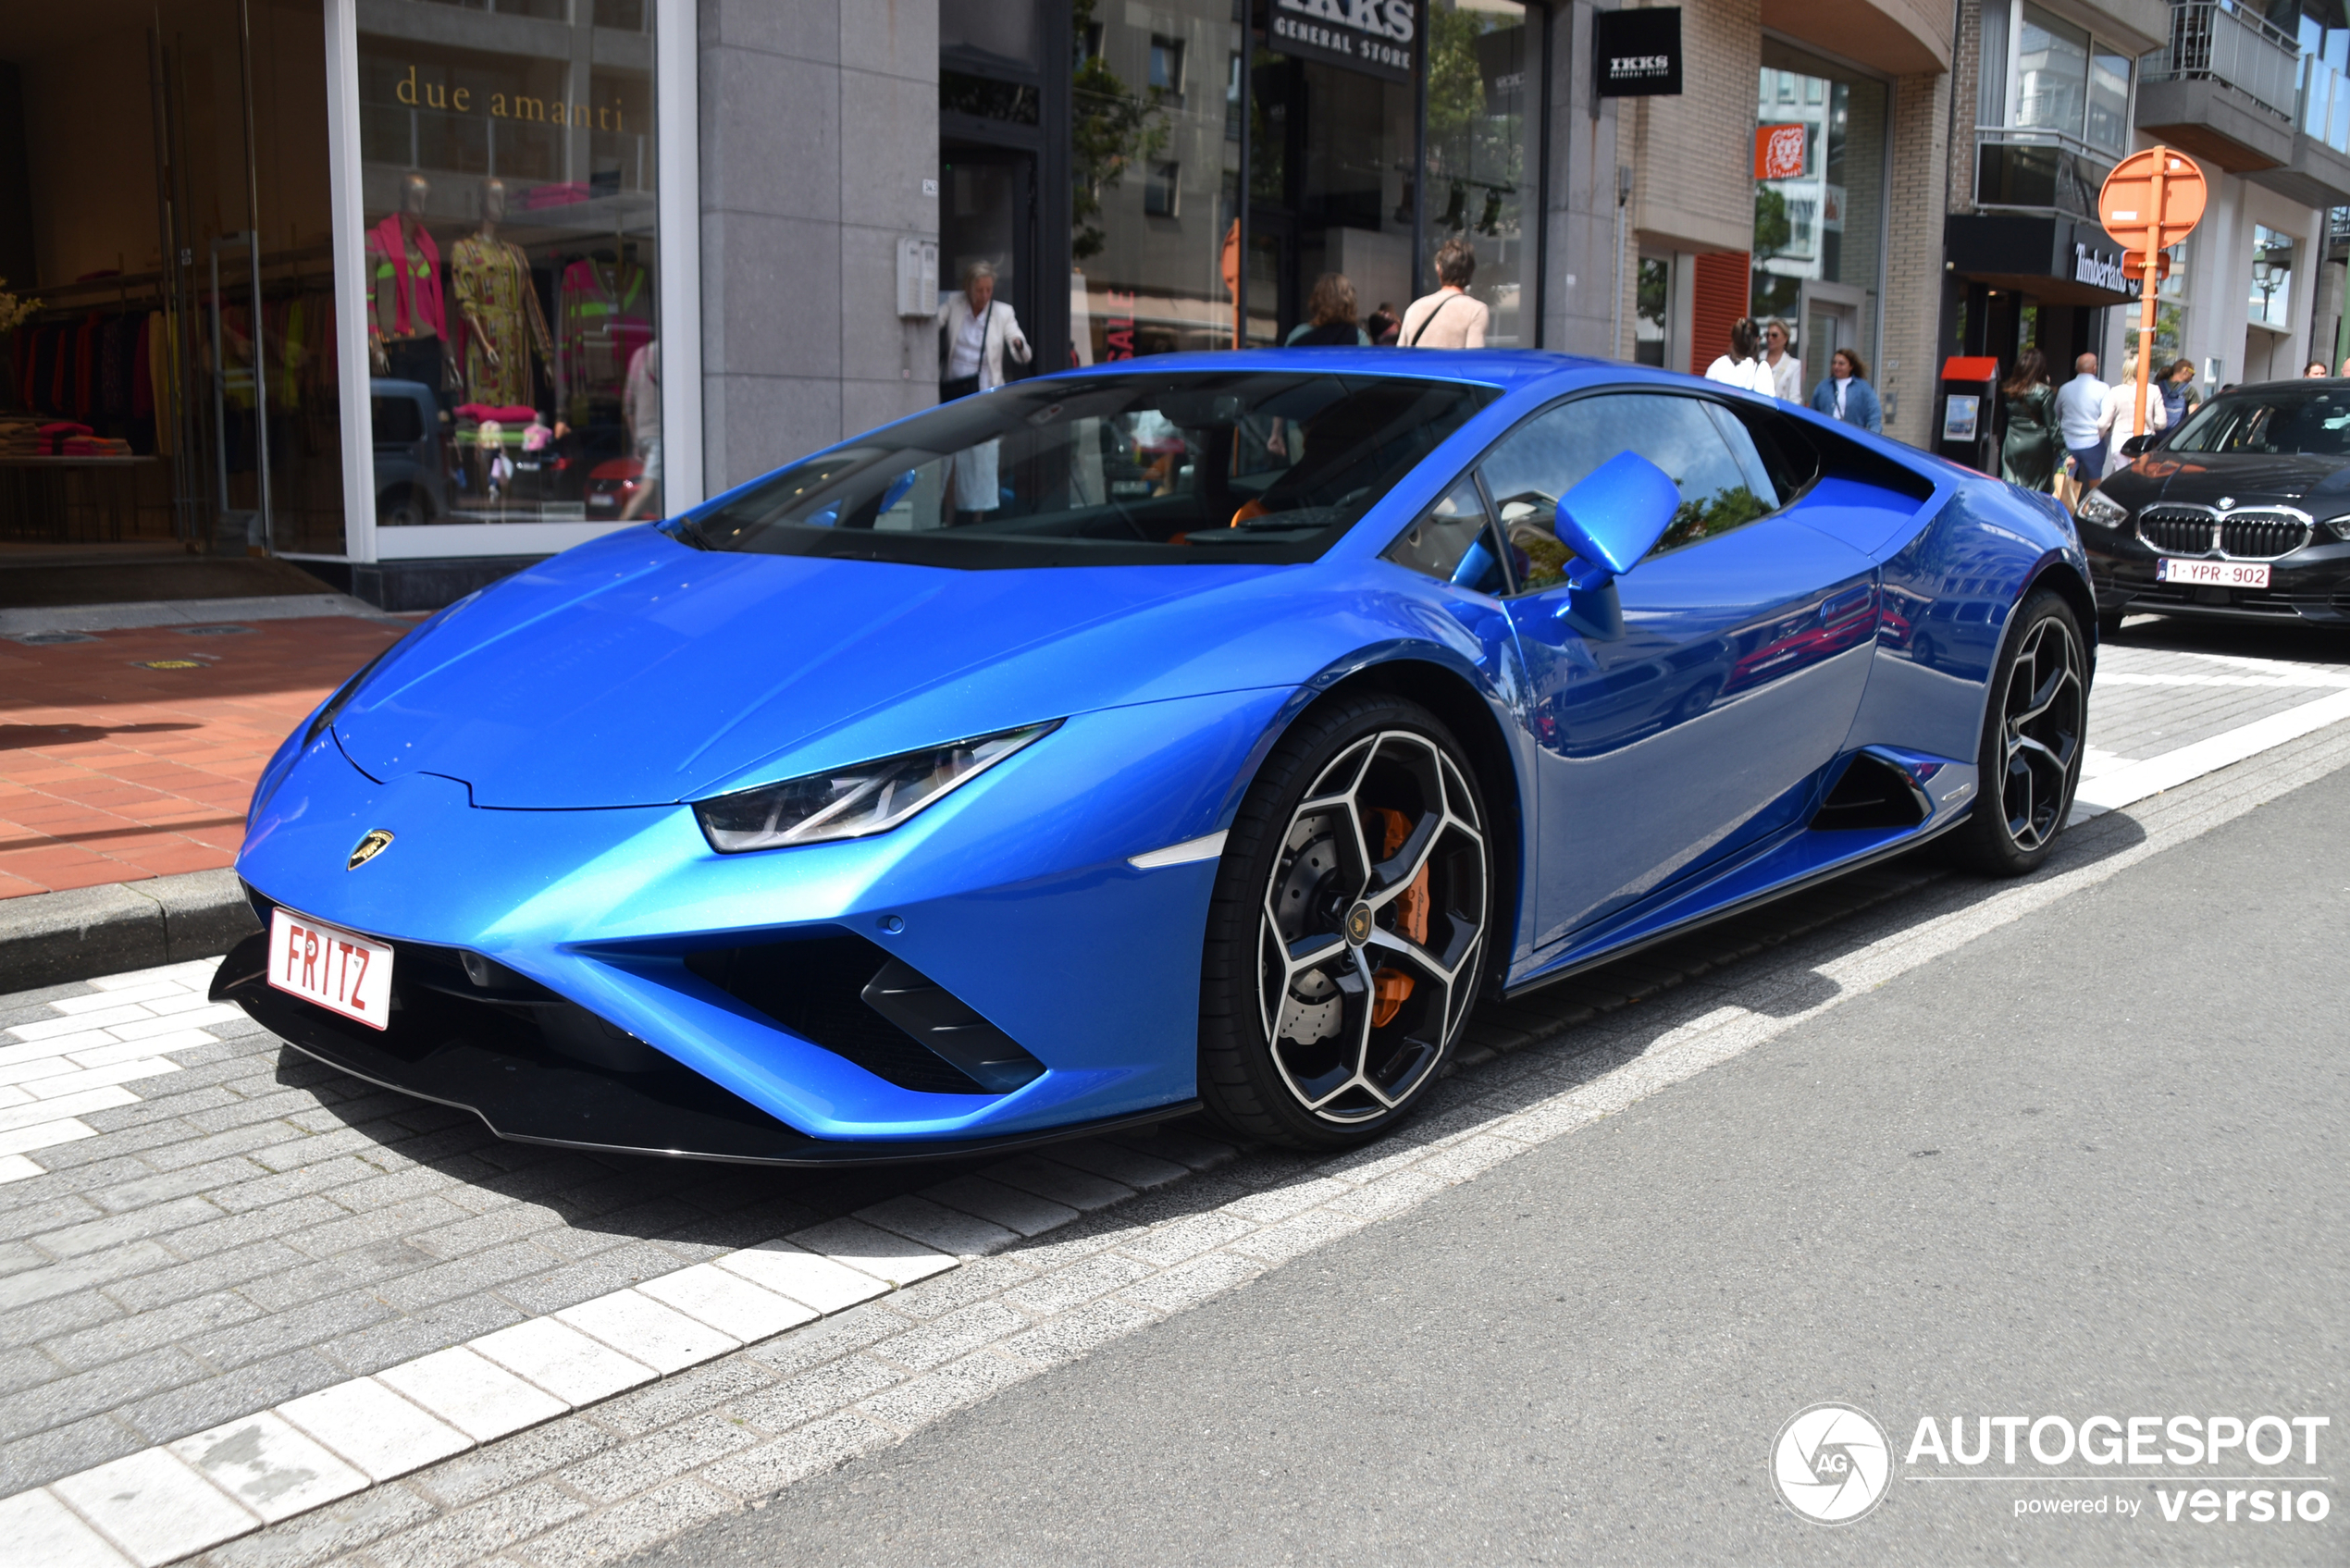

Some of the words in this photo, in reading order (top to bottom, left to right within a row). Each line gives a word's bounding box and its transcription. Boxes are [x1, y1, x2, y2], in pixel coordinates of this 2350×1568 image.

[1274, 16, 1353, 55] GENERAL
[1359, 40, 1411, 69] STORE
[1610, 55, 1668, 70] IKKS
[396, 66, 470, 112] due
[491, 92, 623, 131] amanti
[1107, 289, 1134, 362] SALE
[287, 924, 370, 1011] FRITZ
